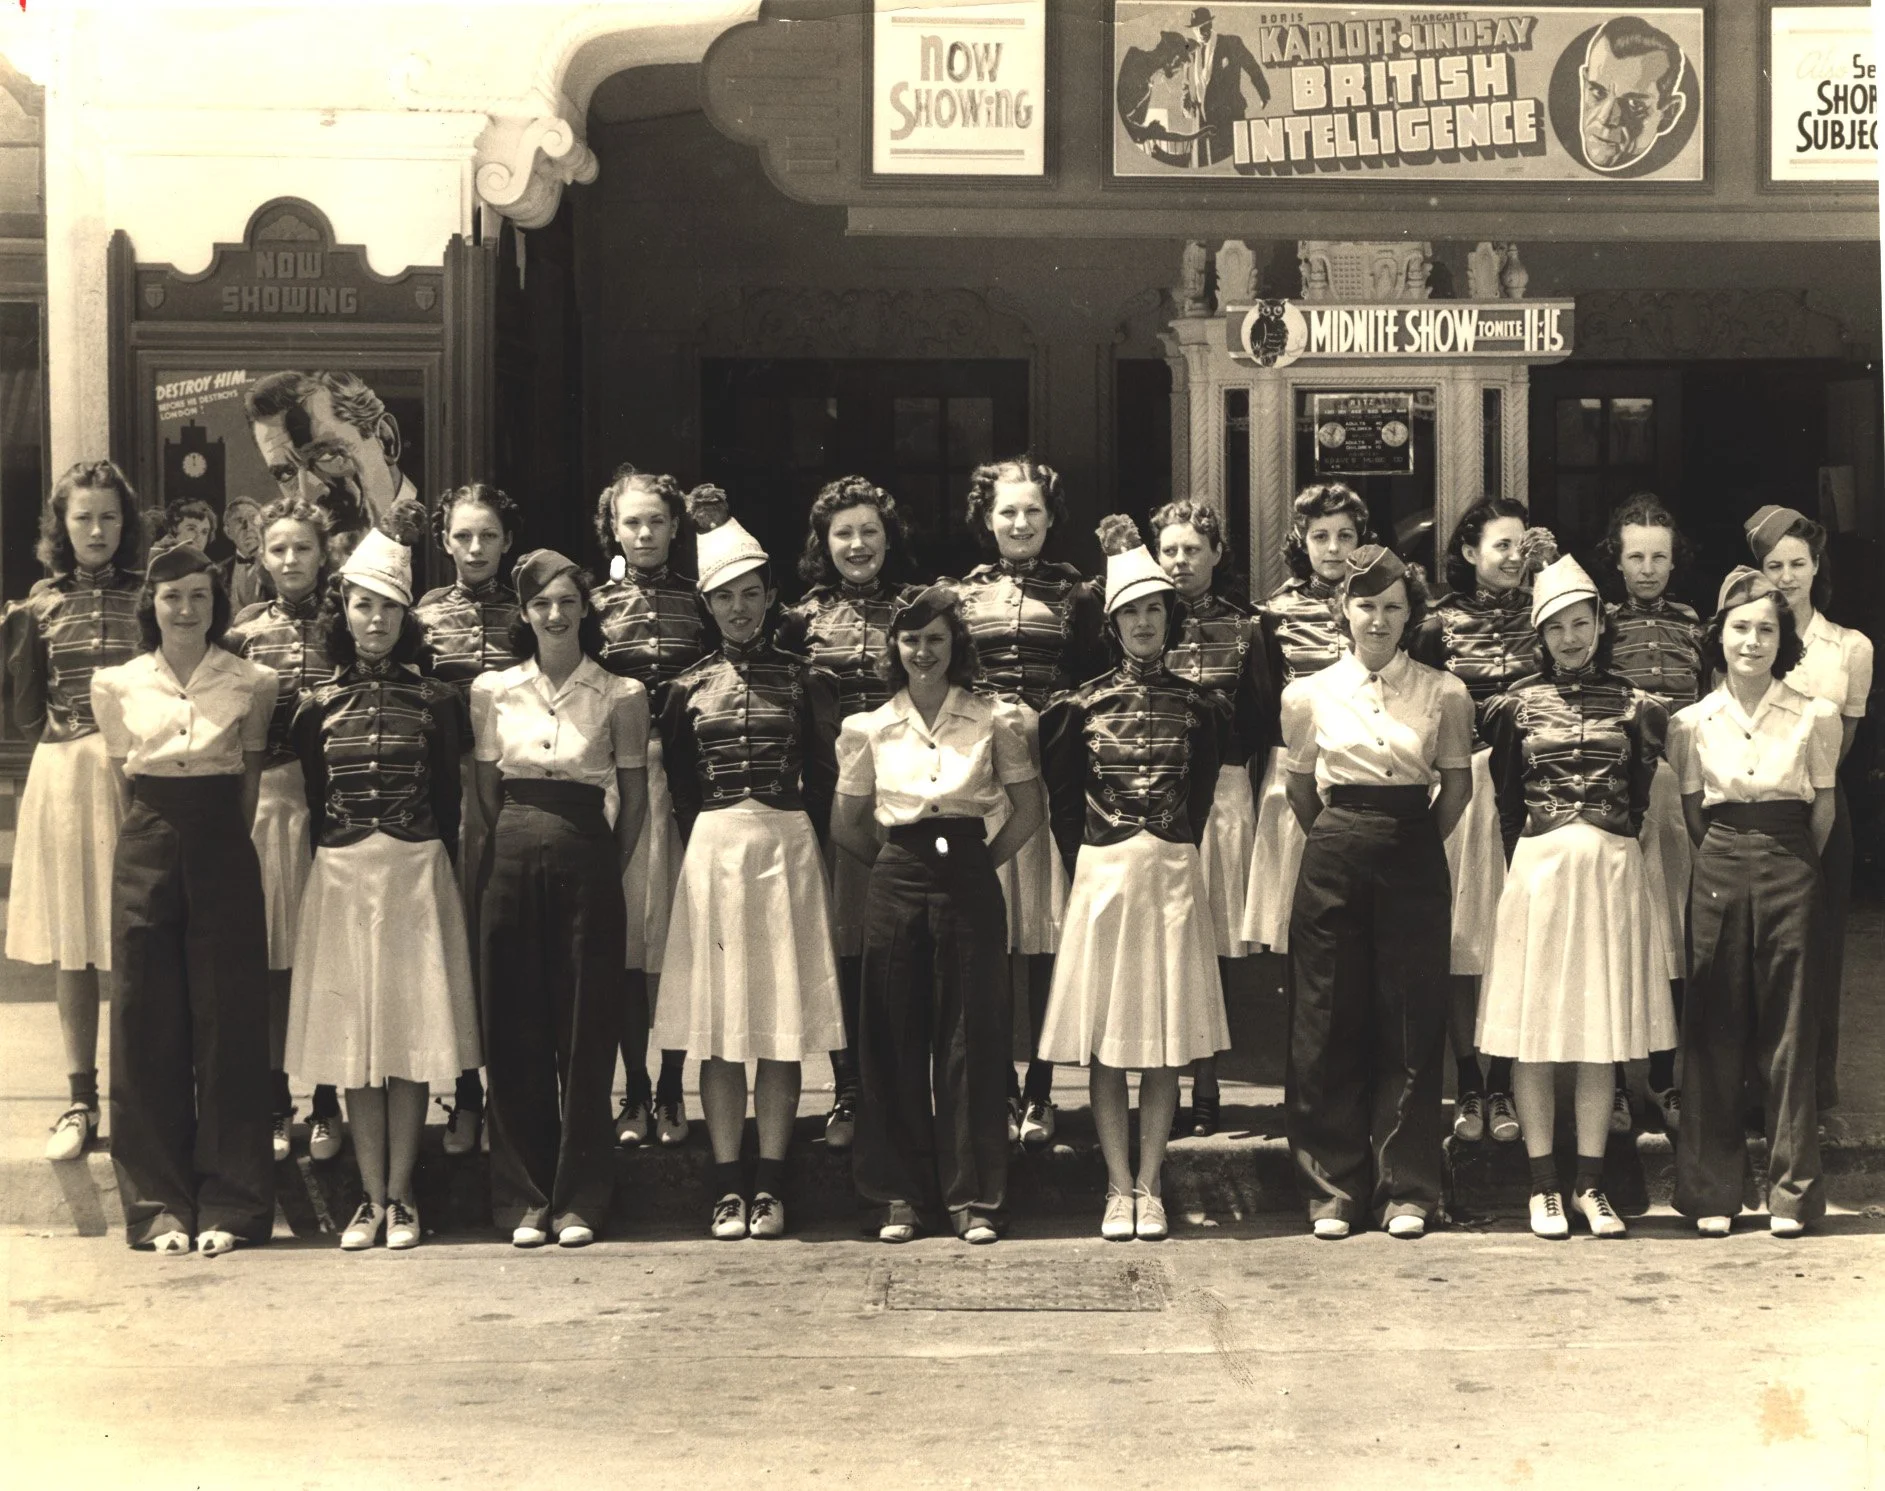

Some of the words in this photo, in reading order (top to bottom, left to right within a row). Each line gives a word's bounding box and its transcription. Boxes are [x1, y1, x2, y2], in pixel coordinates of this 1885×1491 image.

[1261, 12, 1304, 24] BORIS
[1410, 11, 1469, 23] MARGARET
[1260, 18, 1399, 67] KARLOFF
[1410, 16, 1536, 52] LINDSAY
[1292, 52, 1510, 111] BRITISH
[1232, 99, 1538, 165] INTELLIGENCE
[255, 251, 324, 279] NOW
[221, 286, 358, 314] SHOWING
[1310, 309, 1400, 352] MIDNITE
[1404, 309, 1479, 352] SHOW
[1478, 320, 1523, 338] TONITE
[156, 375, 213, 401] DESTROY
[199, 389, 238, 404] DESTROYS
